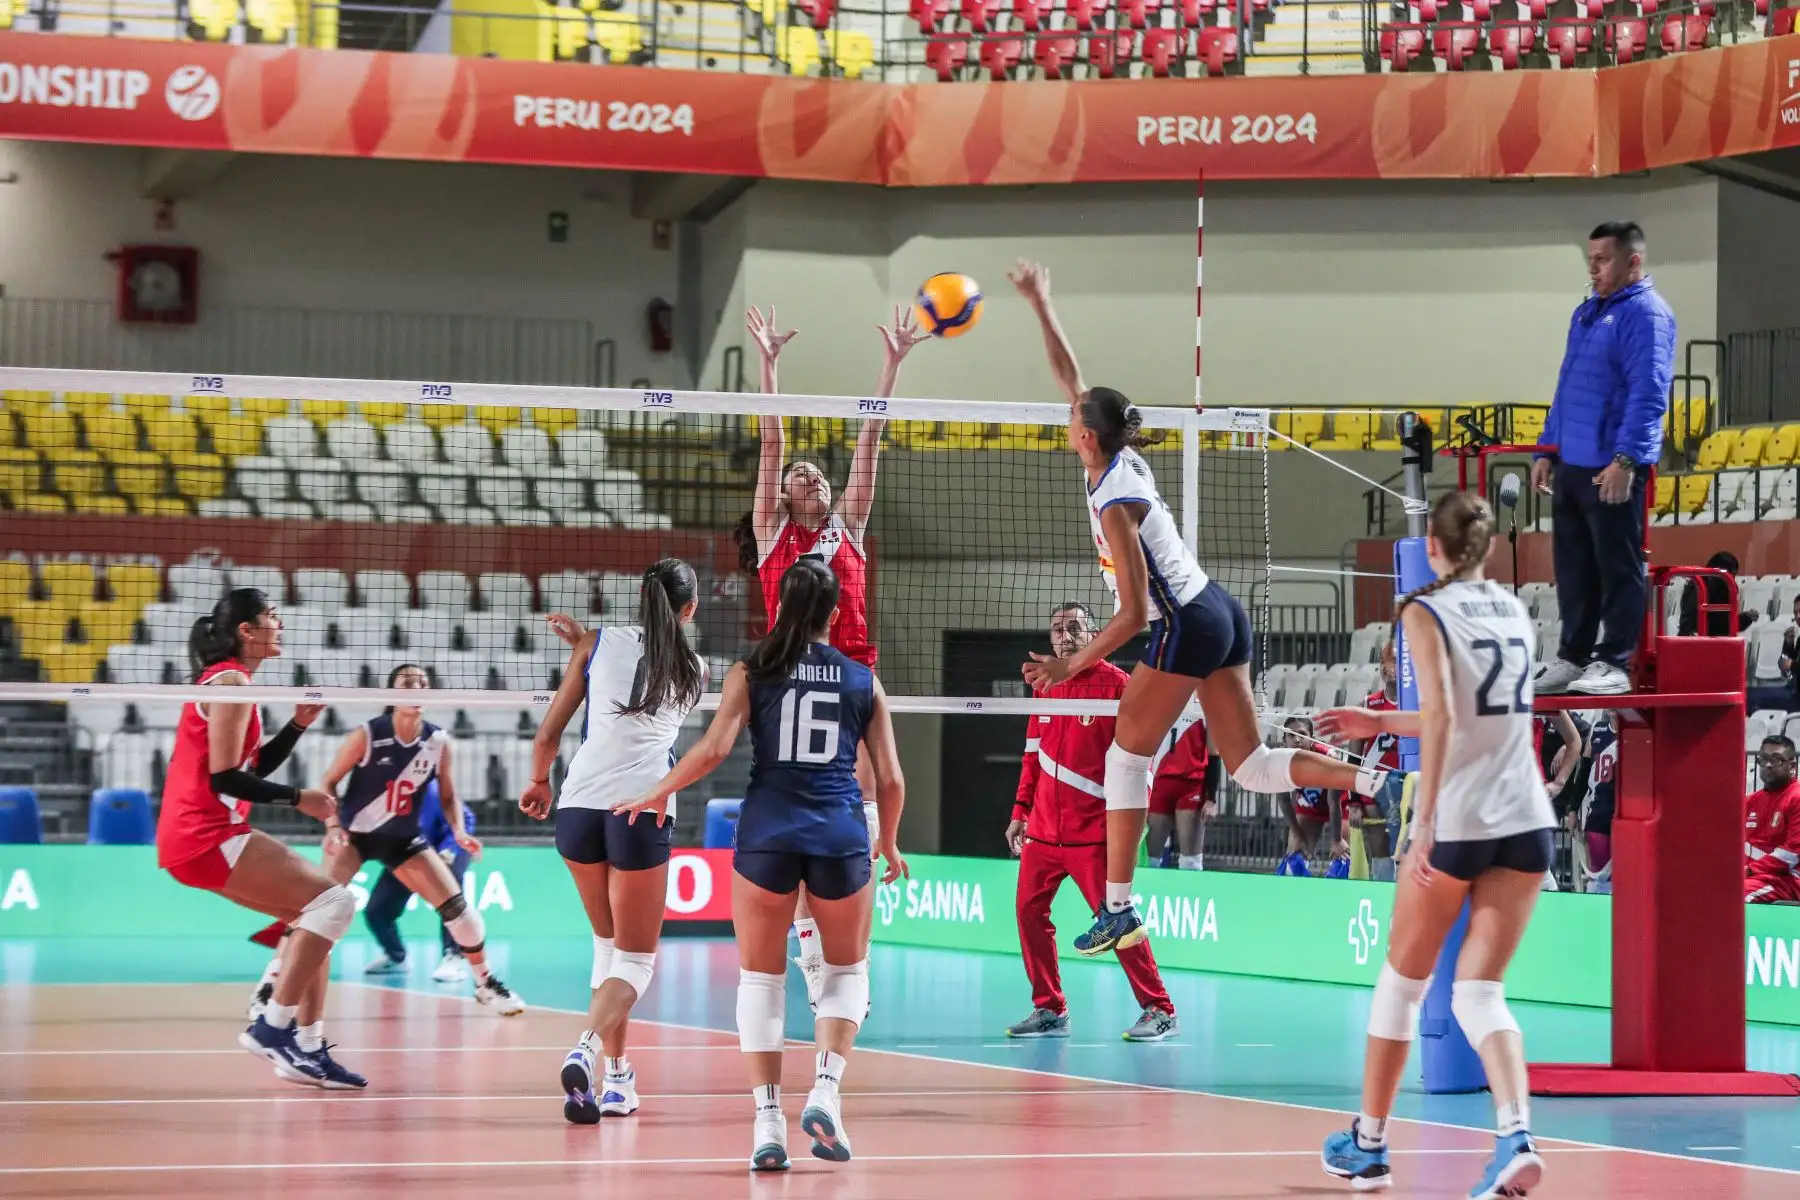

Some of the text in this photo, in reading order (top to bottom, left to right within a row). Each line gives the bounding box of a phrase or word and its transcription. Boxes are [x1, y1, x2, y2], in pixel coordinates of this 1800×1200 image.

[513, 95, 694, 136] PERU 2024
[1137, 112, 1317, 146] PERU 2024
[191, 376, 224, 389] FIVB
[421, 384, 453, 396] FIVB
[643, 392, 673, 404] FIVB
[859, 399, 888, 411] FIVB
[1472, 637, 1532, 717] 22
[778, 687, 840, 764] 16
[386, 779, 415, 816] 16
[905, 878, 985, 924] SANNA
